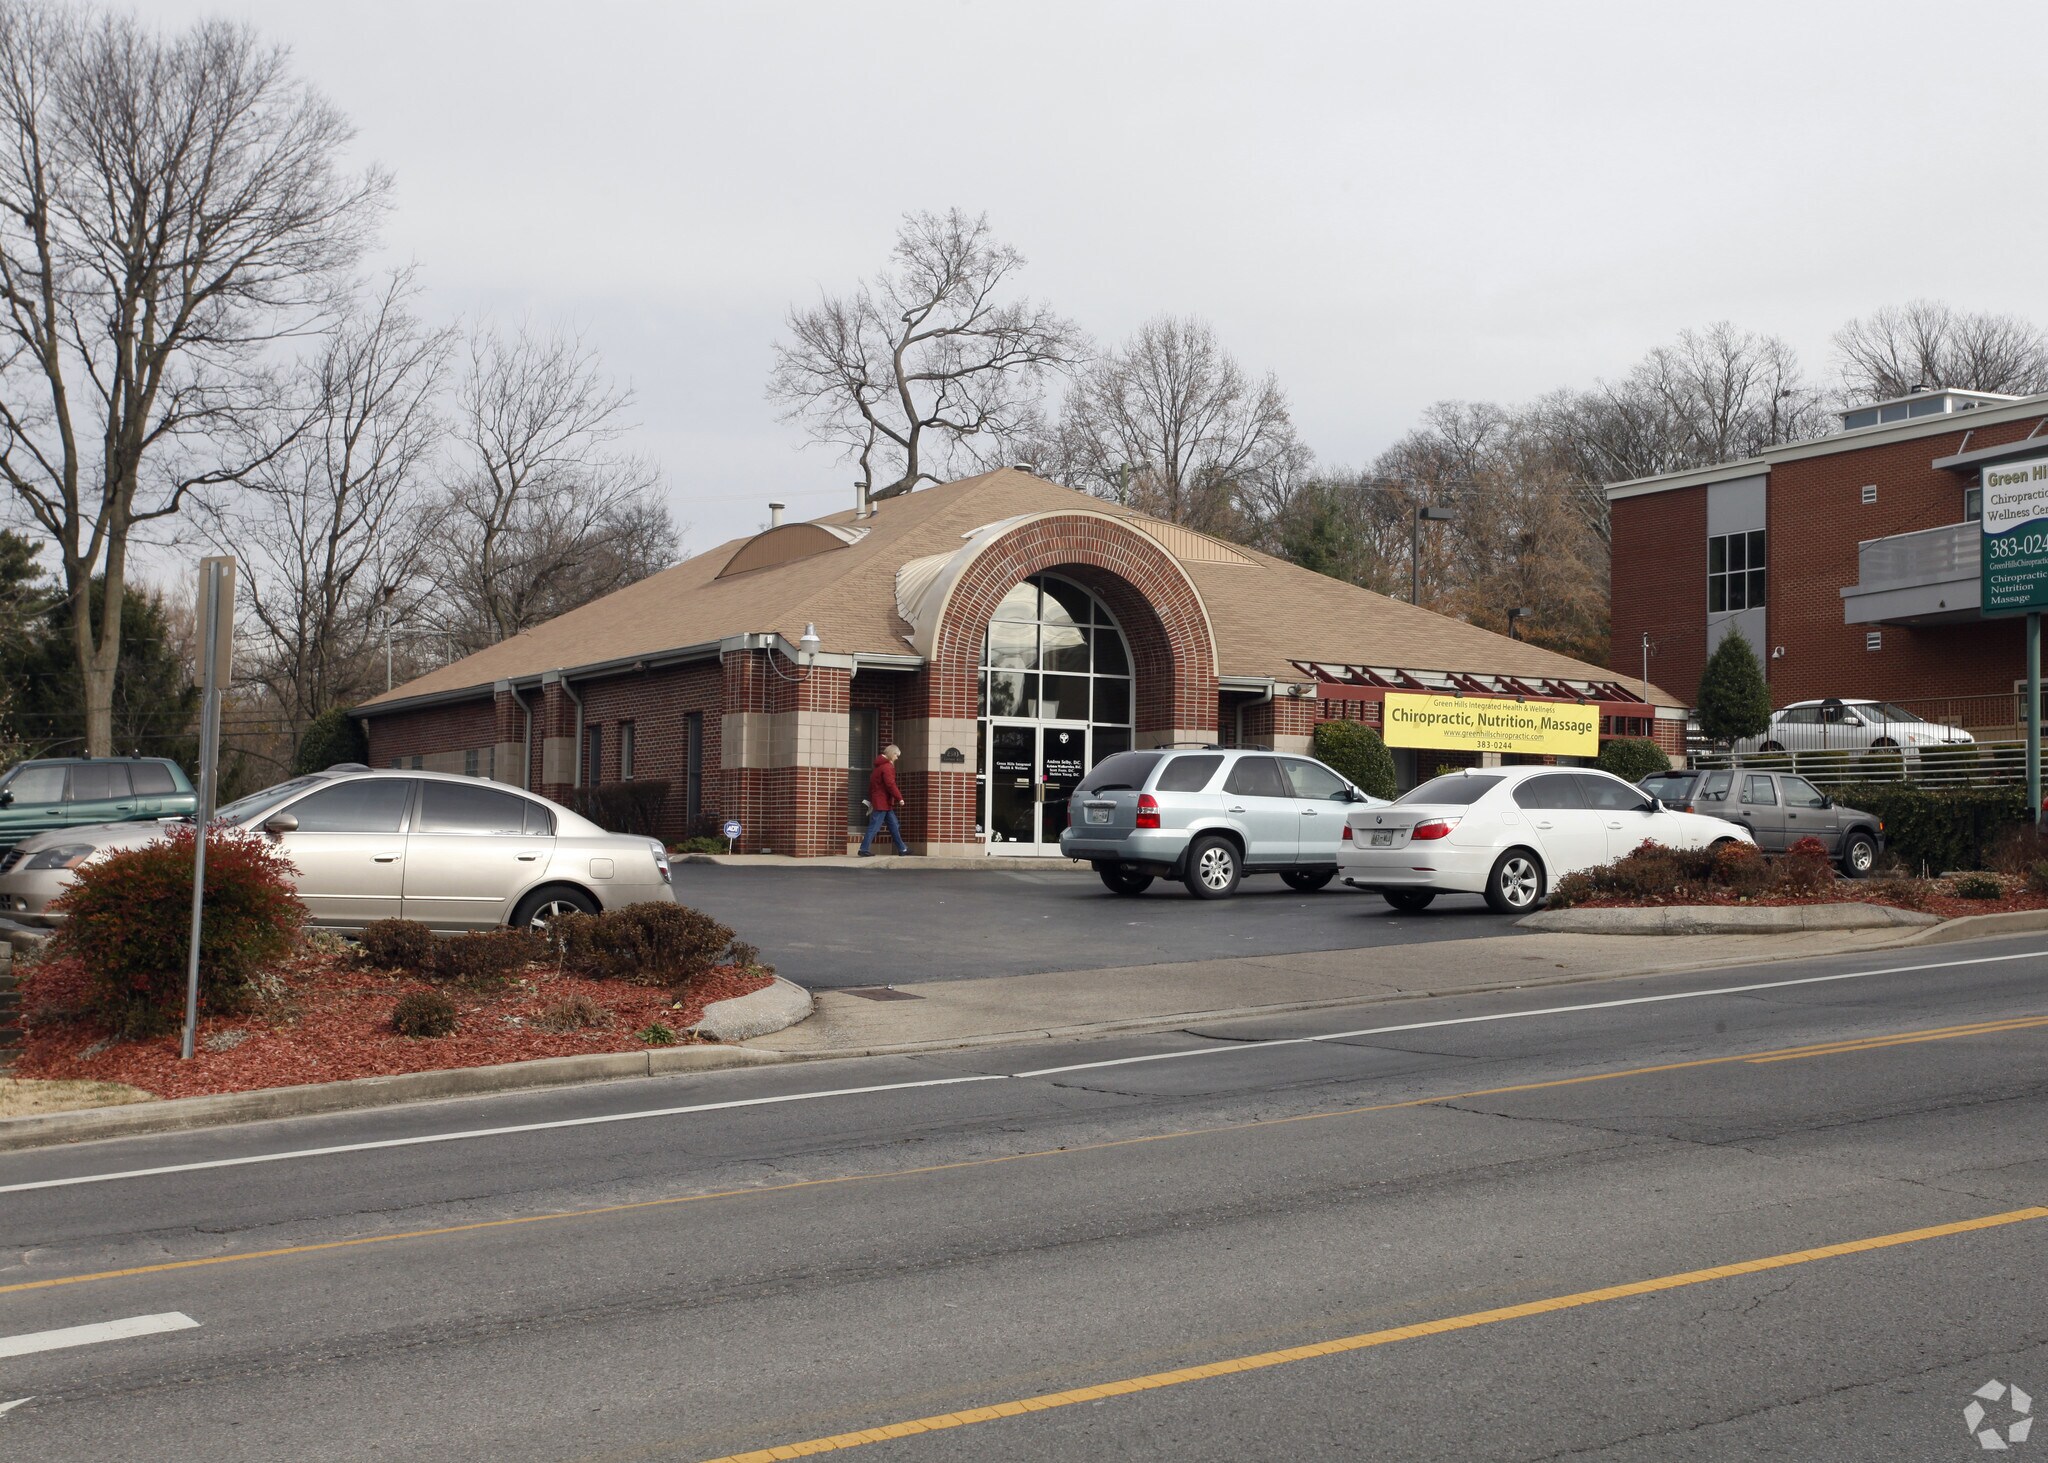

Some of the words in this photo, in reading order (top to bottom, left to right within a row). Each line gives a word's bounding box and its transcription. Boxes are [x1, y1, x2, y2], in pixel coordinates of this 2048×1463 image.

[1988, 471, 2029, 487] Green
[2032, 465, 2048, 481] Hi
[1990, 488, 2048, 505] Chiropractic
[1987, 509, 2030, 521] Wellness
[1991, 571, 2047, 583] Chiropractic
[1991, 584, 2034, 594] Nutrition
[1991, 595, 2030, 604] Massage
[1469, 702, 1501, 711] Integrated
[1530, 705, 1555, 713] Wellness
[1392, 708, 1474, 727] Chiropractic,
[1478, 713, 1537, 730] Nutrition,
[1541, 717, 1592, 735] Massage
[1444, 729, 1544, 741] www.greenhillschiropractic.com
[1477, 741, 1512, 749] 383-0244
